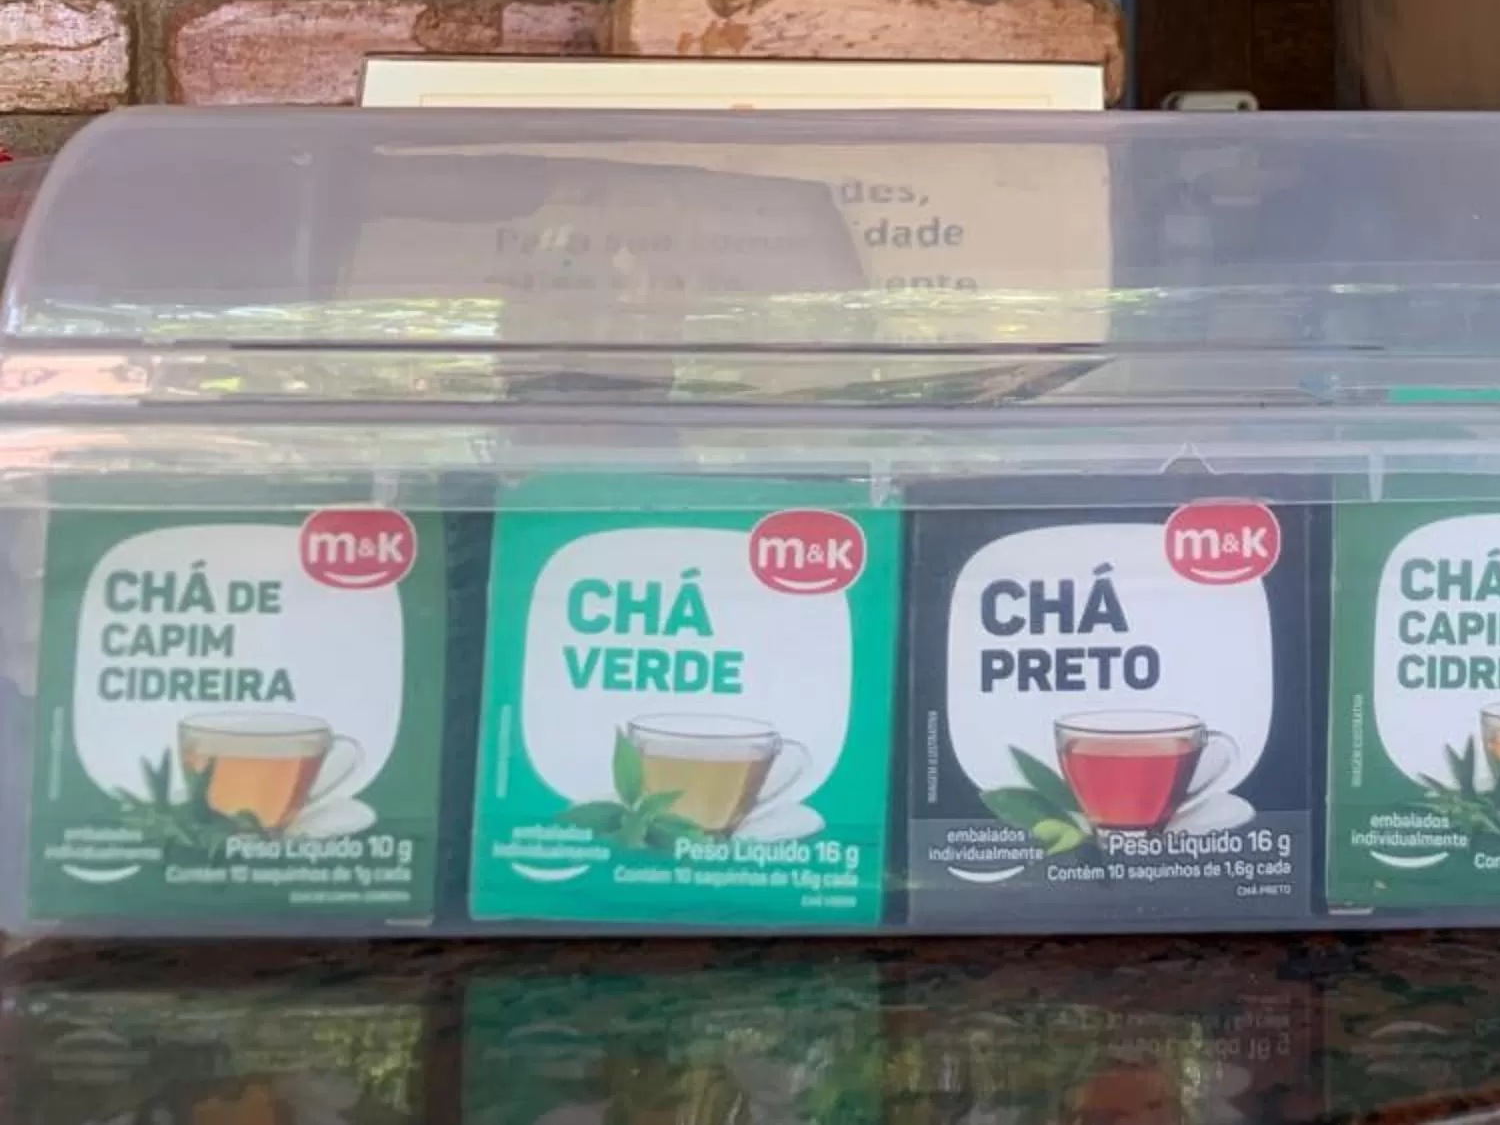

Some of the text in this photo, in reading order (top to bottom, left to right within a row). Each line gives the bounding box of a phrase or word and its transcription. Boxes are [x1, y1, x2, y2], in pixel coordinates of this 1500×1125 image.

[104, 560, 282, 615] CHÁ DE
[567, 567, 713, 637] CHÁ
[980, 561, 1128, 637] CHÁ
[100, 623, 235, 658] CAPIM
[97, 667, 296, 702] CIDREIRA
[563, 646, 744, 694] VERDE
[980, 645, 1161, 693] PRETO
[947, 826, 1025, 843] embalados
[1370, 812, 1449, 829] embalados
[367, 835, 394, 858] 10
[398, 839, 413, 864] g
[674, 837, 729, 862] Peso
[814, 840, 841, 863] 16
[845, 844, 860, 869] g
[928, 844, 1044, 861] individualmente
[1109, 833, 1162, 856] Peso
[1247, 830, 1273, 852] 16
[1277, 833, 1291, 857] g
[1352, 829, 1468, 847] individualmente
[1108, 863, 1124, 880] 10
[1203, 861, 1221, 877] de
[1256, 859, 1291, 875] cada
